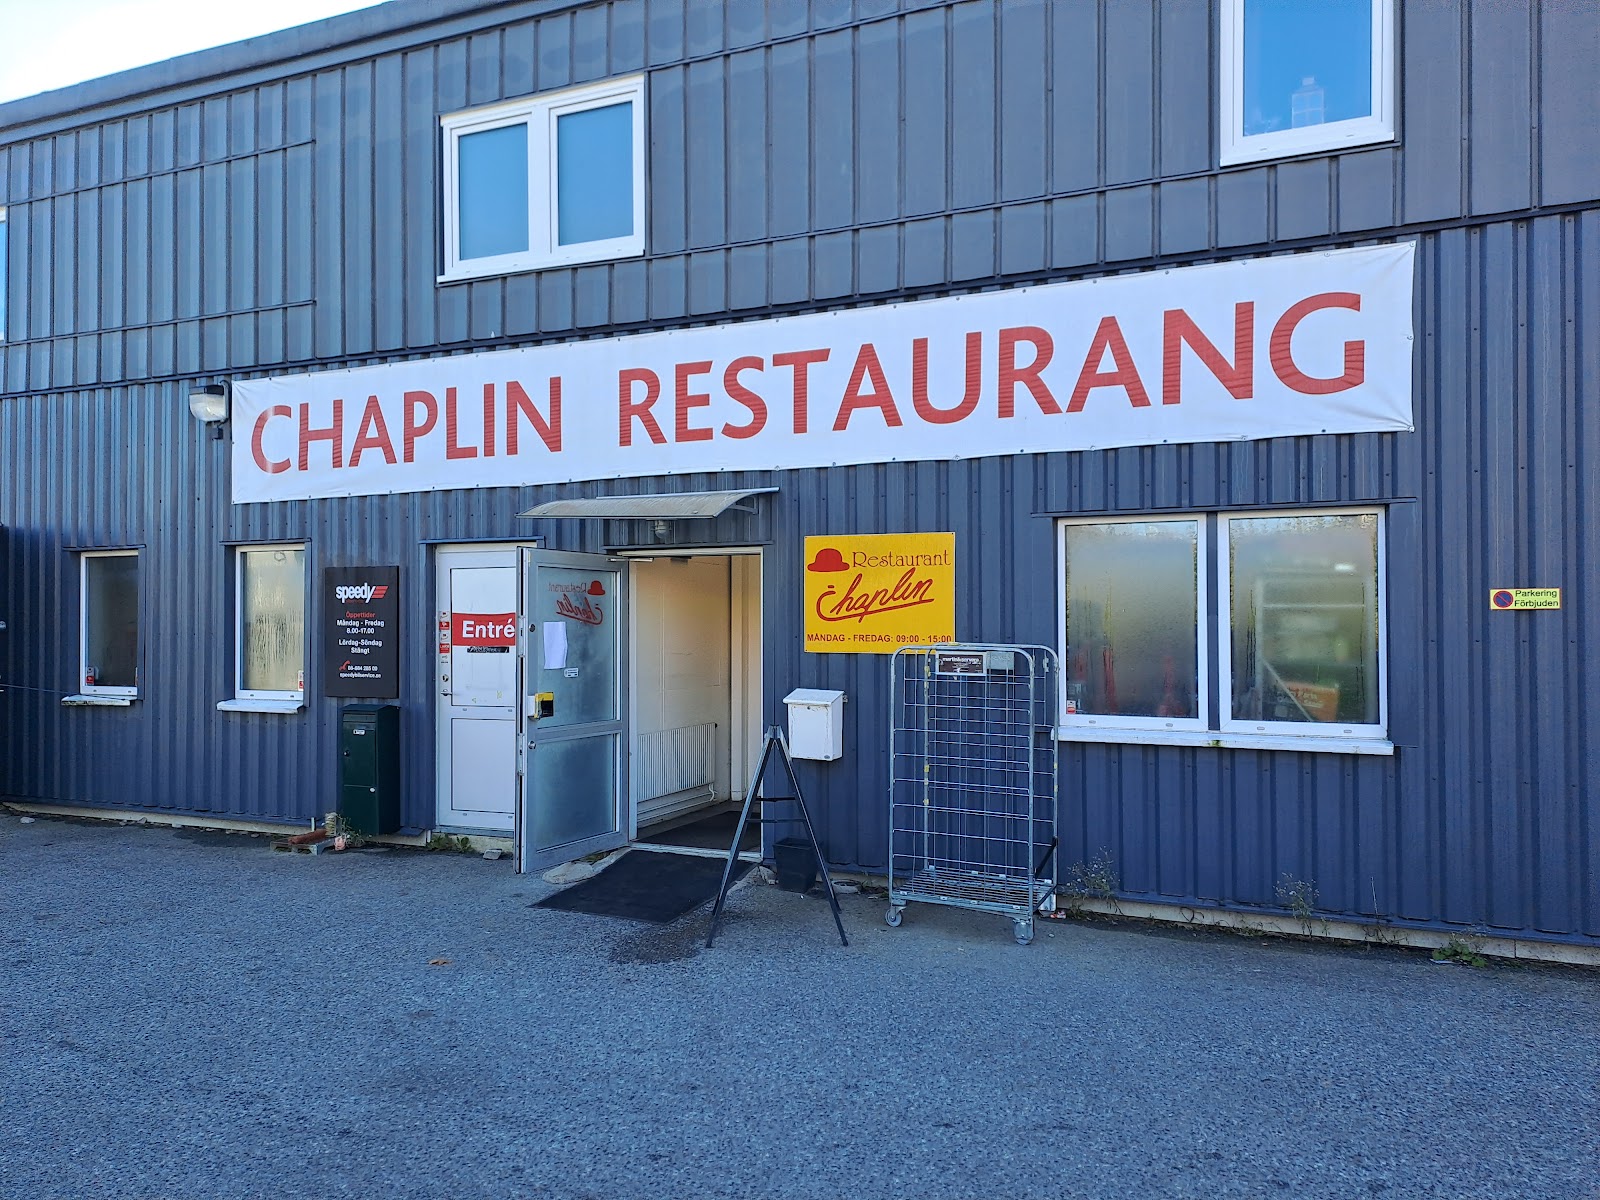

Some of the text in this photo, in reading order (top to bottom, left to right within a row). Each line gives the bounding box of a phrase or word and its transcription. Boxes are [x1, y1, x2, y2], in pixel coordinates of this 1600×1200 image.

[250, 291, 1366, 474] CHAPLIN RESTAURANG
[852, 549, 951, 568] Restaurant
[335, 582, 376, 603] speedy
[816, 567, 935, 623] Chaplin
[1515, 590, 1557, 598] Parkering
[1514, 600, 1559, 608] Förbjuden
[345, 611, 376, 619] Öppettider
[336, 619, 360, 627] Måndag
[364, 619, 385, 628] Fredag
[462, 618, 516, 639] Entré
[338, 638, 383, 648] Lördag-Söndag
[807, 633, 845, 642] MÅNDAG
[853, 634, 893, 643] FREDAG:
[896, 634, 919, 643] 09:00
[929, 634, 952, 643] 15:00
[350, 647, 370, 655] Stängt
